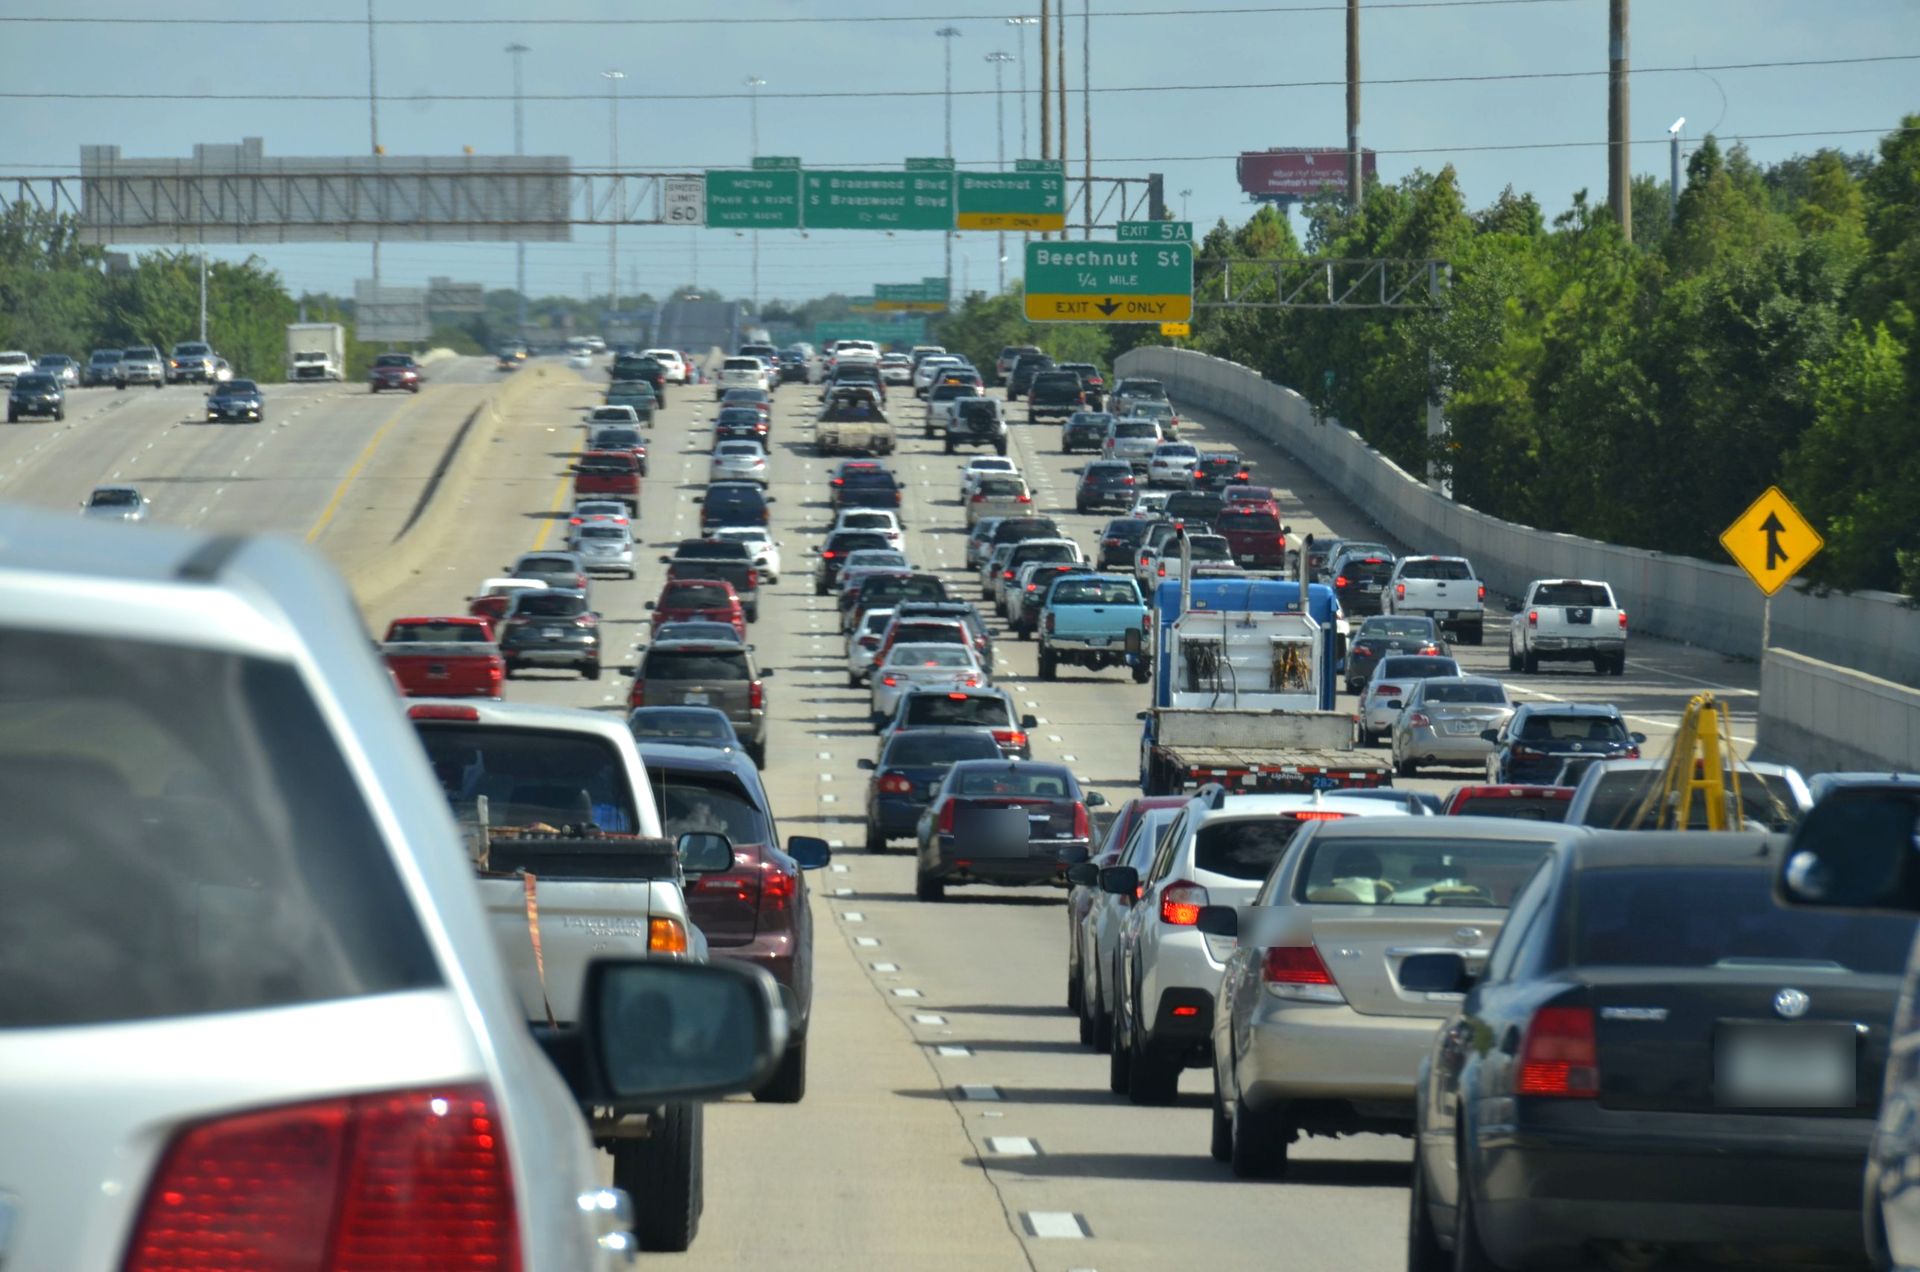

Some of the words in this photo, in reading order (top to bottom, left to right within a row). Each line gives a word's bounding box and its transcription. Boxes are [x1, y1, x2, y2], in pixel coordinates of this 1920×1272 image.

[809, 178, 820, 189] N
[963, 178, 1031, 190] Beechnut
[1041, 179, 1058, 190] St
[809, 193, 820, 206] S
[671, 206, 698, 221] 60
[1121, 226, 1150, 237] EXIT
[1161, 224, 1188, 240] 5A
[1037, 250, 1138, 266] Beechnut
[1157, 251, 1180, 267] St
[1109, 275, 1139, 286] MILE
[1056, 302, 1089, 313] EXIT
[1127, 302, 1167, 314] ONLY
